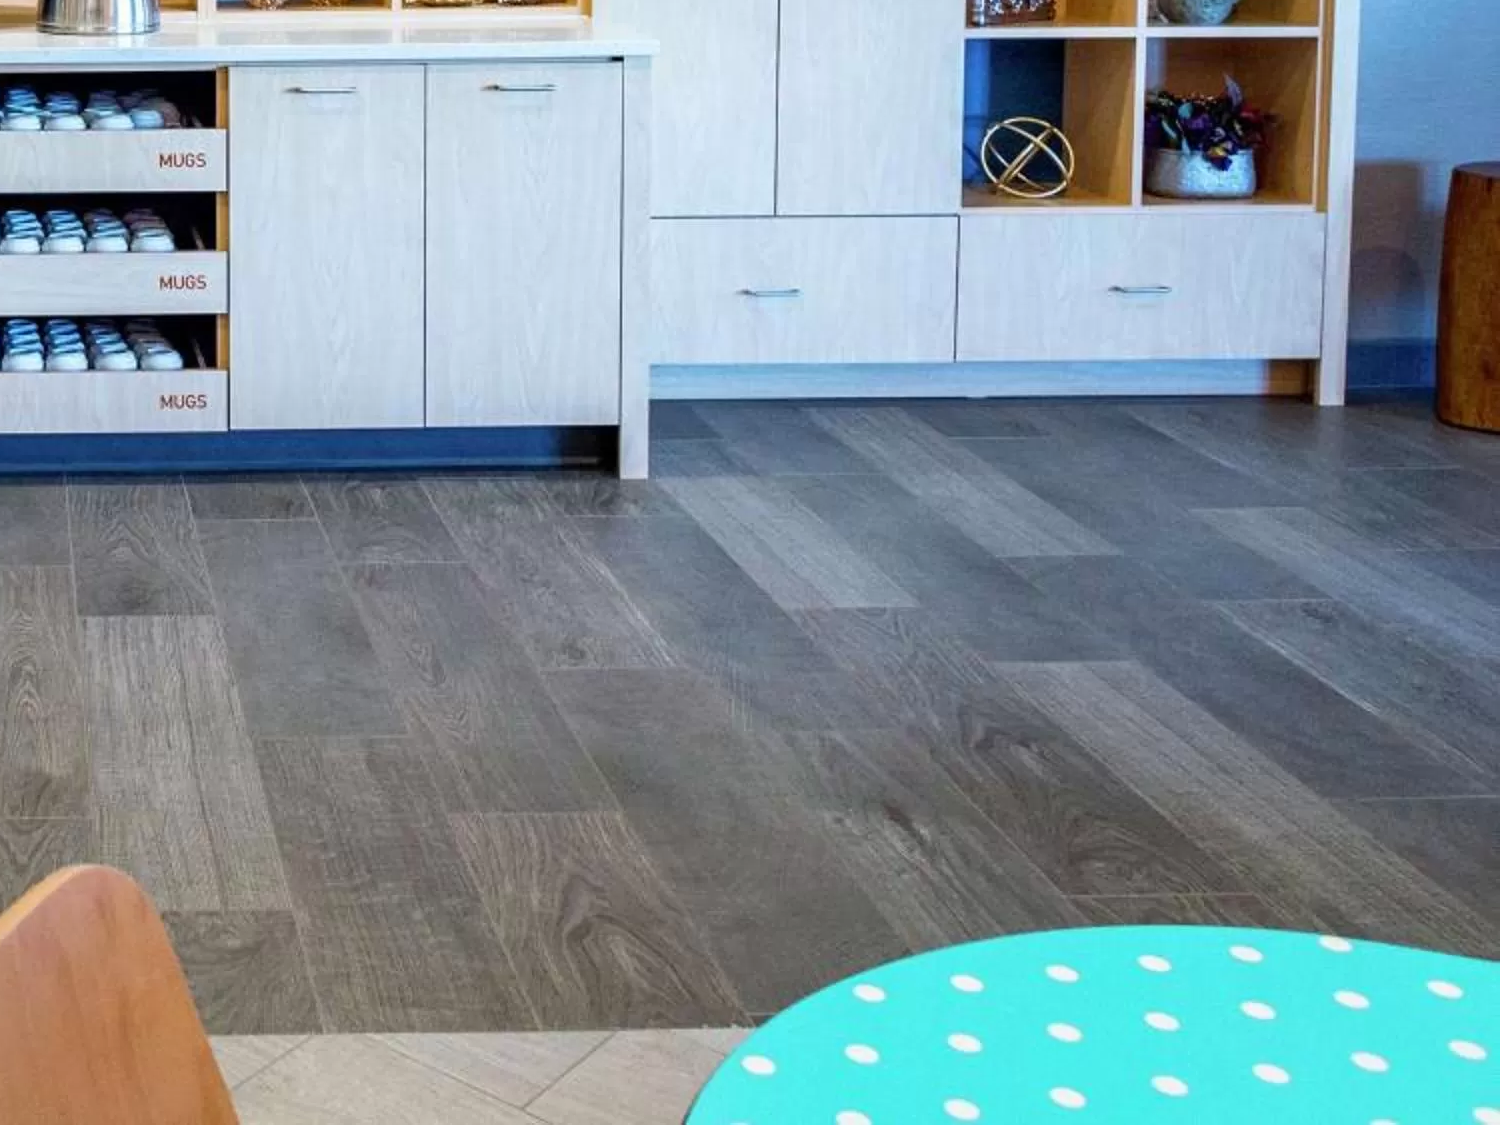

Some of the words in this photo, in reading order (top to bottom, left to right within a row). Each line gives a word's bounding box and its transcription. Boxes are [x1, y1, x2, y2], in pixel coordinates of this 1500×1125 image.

[158, 152, 207, 169] MUGS
[158, 275, 208, 290] MUGS
[159, 394, 208, 410] MUGS
